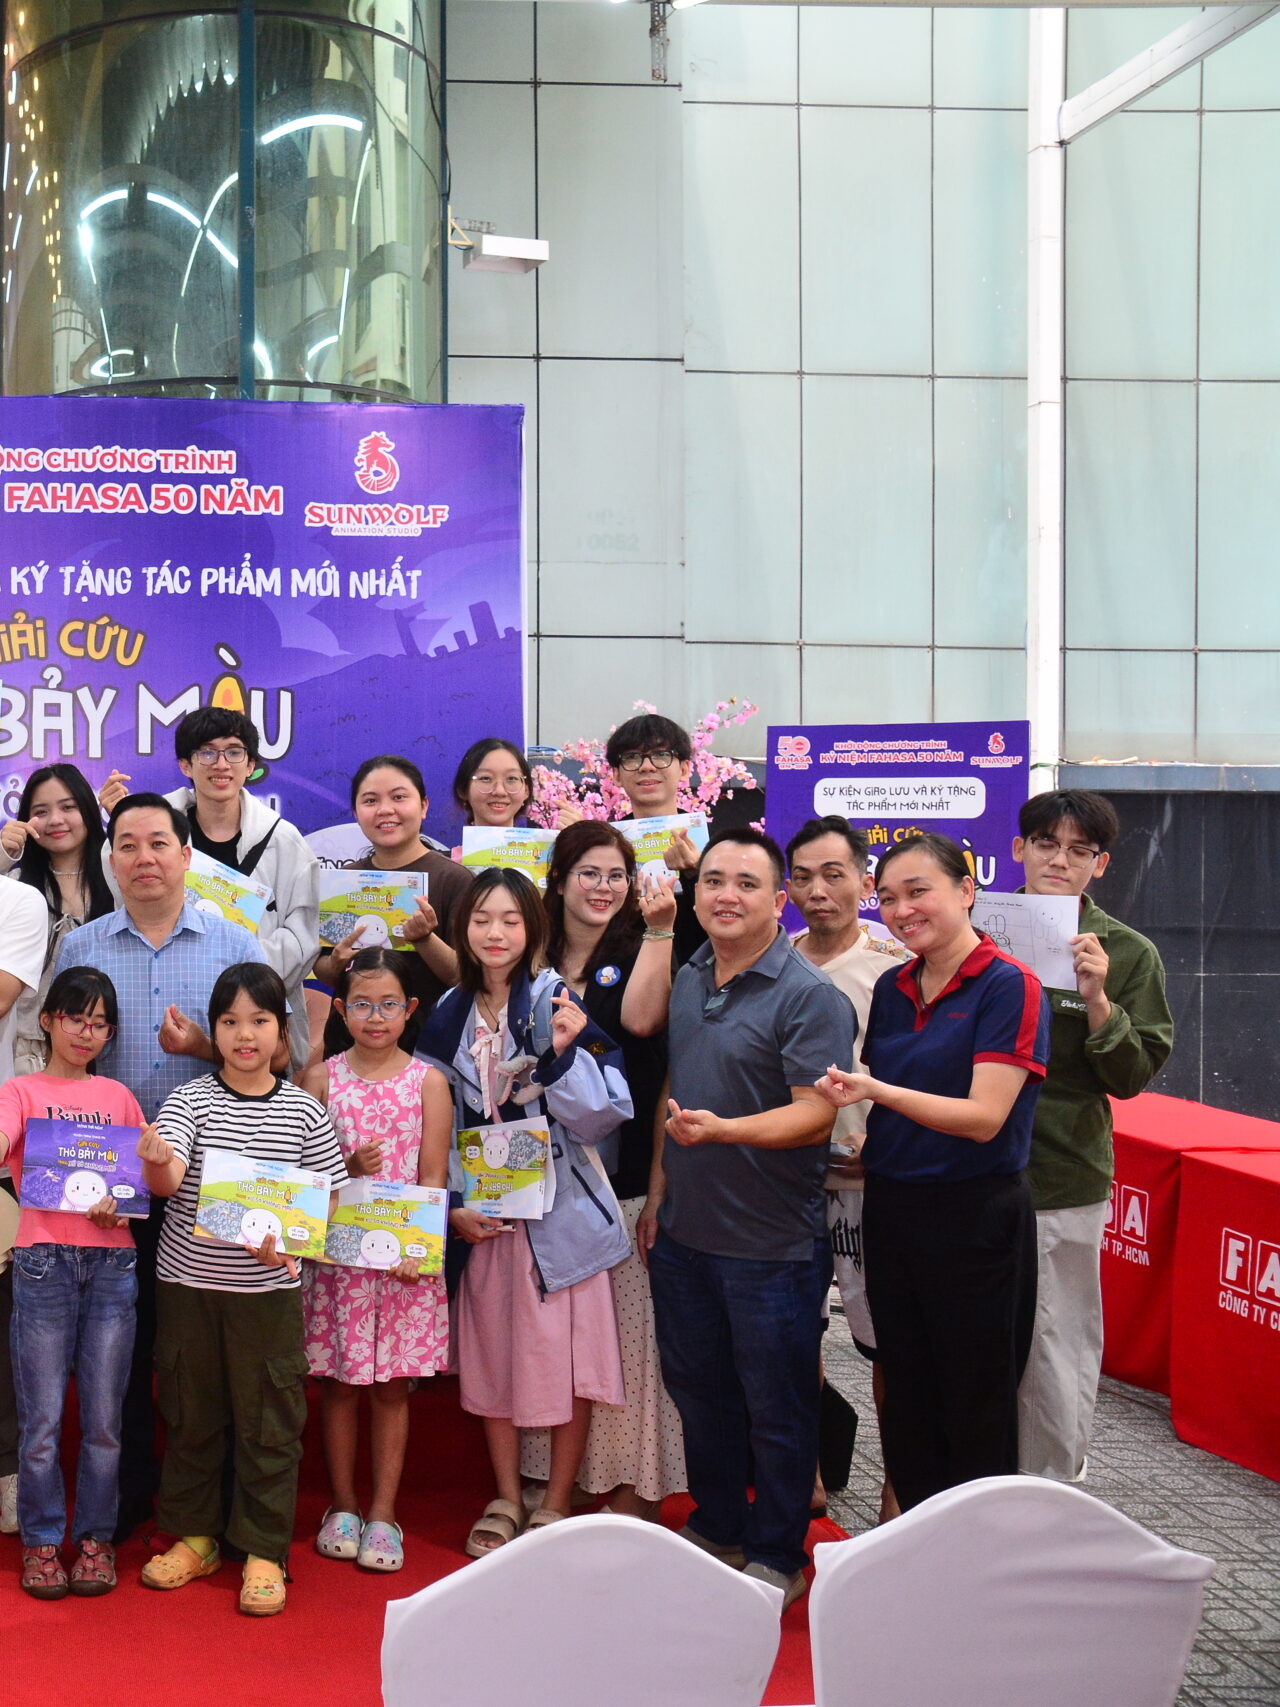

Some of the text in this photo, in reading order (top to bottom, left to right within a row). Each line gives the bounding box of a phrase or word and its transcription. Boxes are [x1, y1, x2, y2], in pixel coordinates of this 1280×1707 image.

[44, 447, 154, 472] CHƯƠNG
[160, 446, 235, 472] TRÌNH
[6, 483, 146, 512] FAHASA
[153, 485, 194, 513] 50
[202, 480, 282, 514] NĂM
[306, 503, 449, 527] SUNWOLF
[333, 527, 421, 536] ANIMATION STUDIO
[10, 562, 50, 596] KÝ
[59, 560, 132, 602] TẶNG
[141, 559, 192, 596] TÁC
[200, 552, 282, 598] PHẨM
[290, 559, 340, 599] MỚI
[348, 555, 423, 600] NHẤT
[58, 616, 146, 667] CỨU
[777, 735, 811, 757] 50
[920, 739, 947, 749] TRÌNH
[775, 756, 812, 764] FAHASA
[838, 751, 867, 766] NIỆM
[869, 752, 916, 763] FAHASA
[918, 751, 933, 762] 50
[934, 750, 964, 762] NĂM
[823, 786, 836, 798] SỰ
[889, 787, 911, 797] LƯU
[913, 785, 928, 796] VÀ
[930, 785, 943, 796] KÝ
[847, 799, 864, 811] TÁC
[868, 797, 897, 811] PHẨM
[922, 799, 951, 811] NHẤT
[632, 840, 643, 850] HỎ
[58, 1146, 76, 1158] THỎ
[78, 1147, 96, 1160] BẢY
[236, 1181, 255, 1192] THỎ
[355, 1203, 372, 1214] THỎ
[1111, 1239, 1151, 1267] TP.HCM
[1218, 1289, 1249, 1318] CÔNG
[1252, 1303, 1267, 1325] TY
